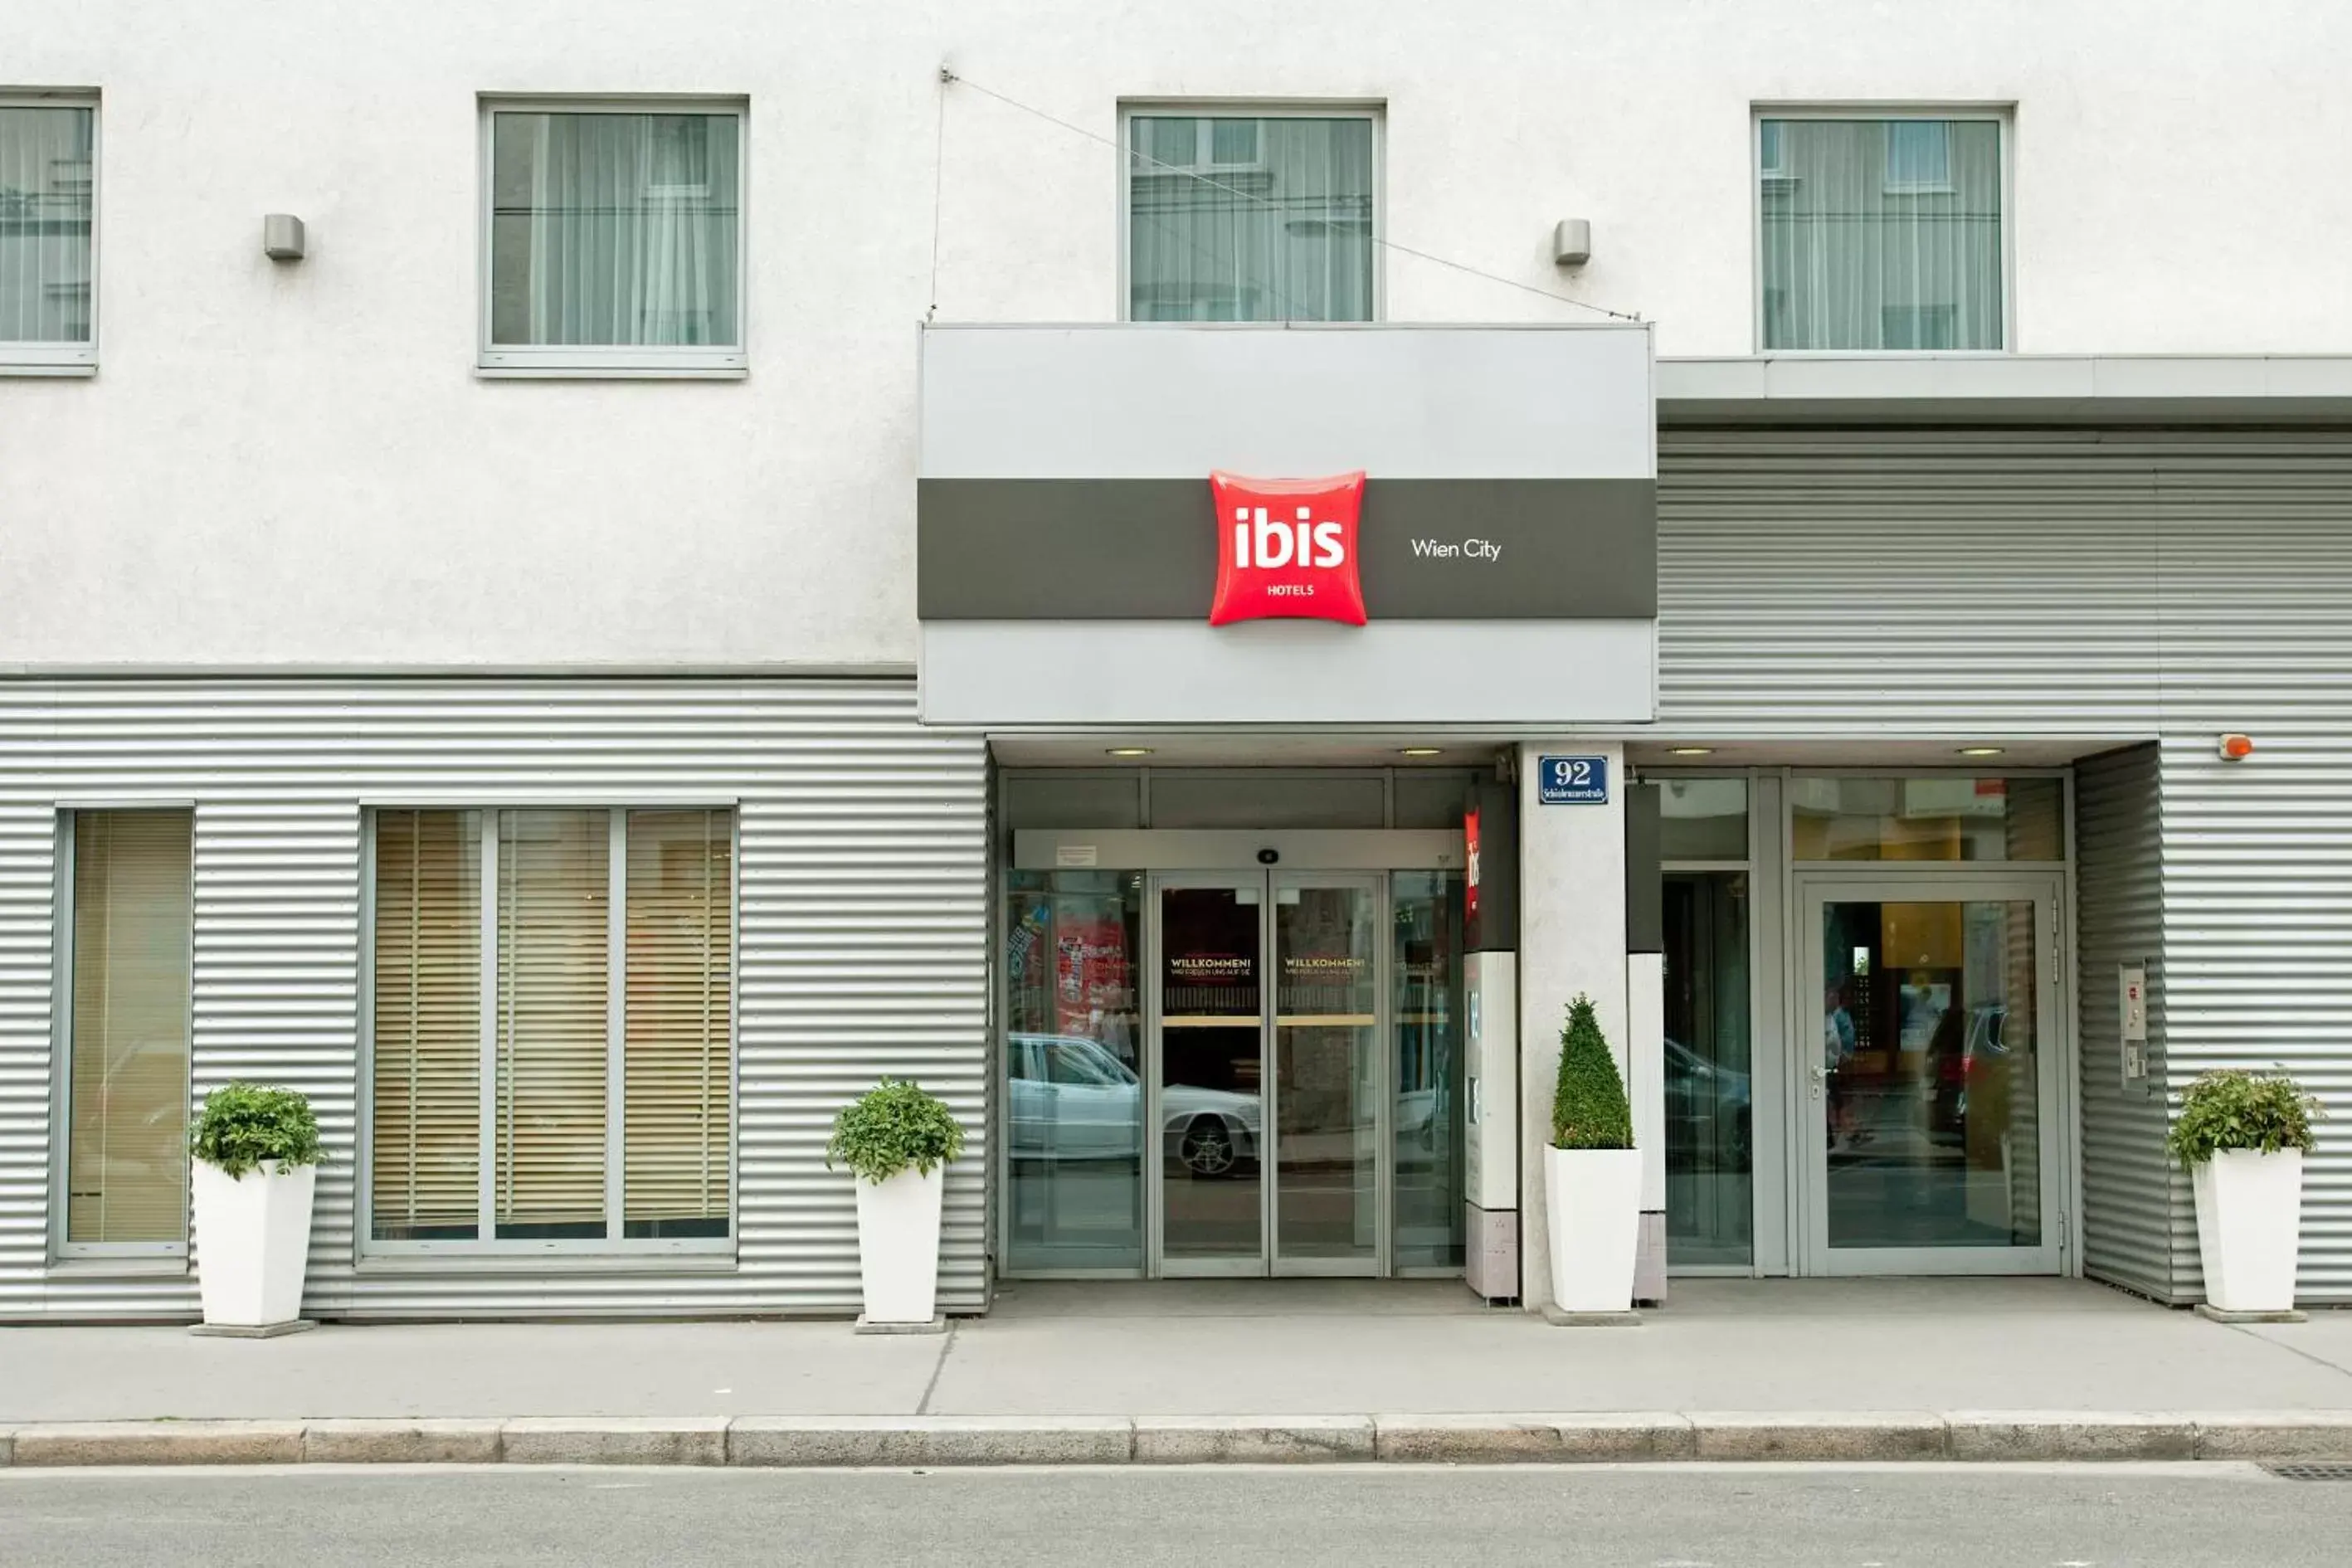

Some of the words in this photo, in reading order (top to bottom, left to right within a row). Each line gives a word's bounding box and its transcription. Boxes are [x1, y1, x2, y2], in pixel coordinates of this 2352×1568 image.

[1235, 507, 1345, 568] ibis
[1411, 538, 1459, 558] Wien
[1463, 538, 1502, 562] City
[1268, 585, 1315, 597] HOTELS
[1555, 761, 1591, 786] 92
[1171, 958, 1251, 968] WILLKOMMEN!
[1285, 957, 1366, 967] WILLKOMMEN!
